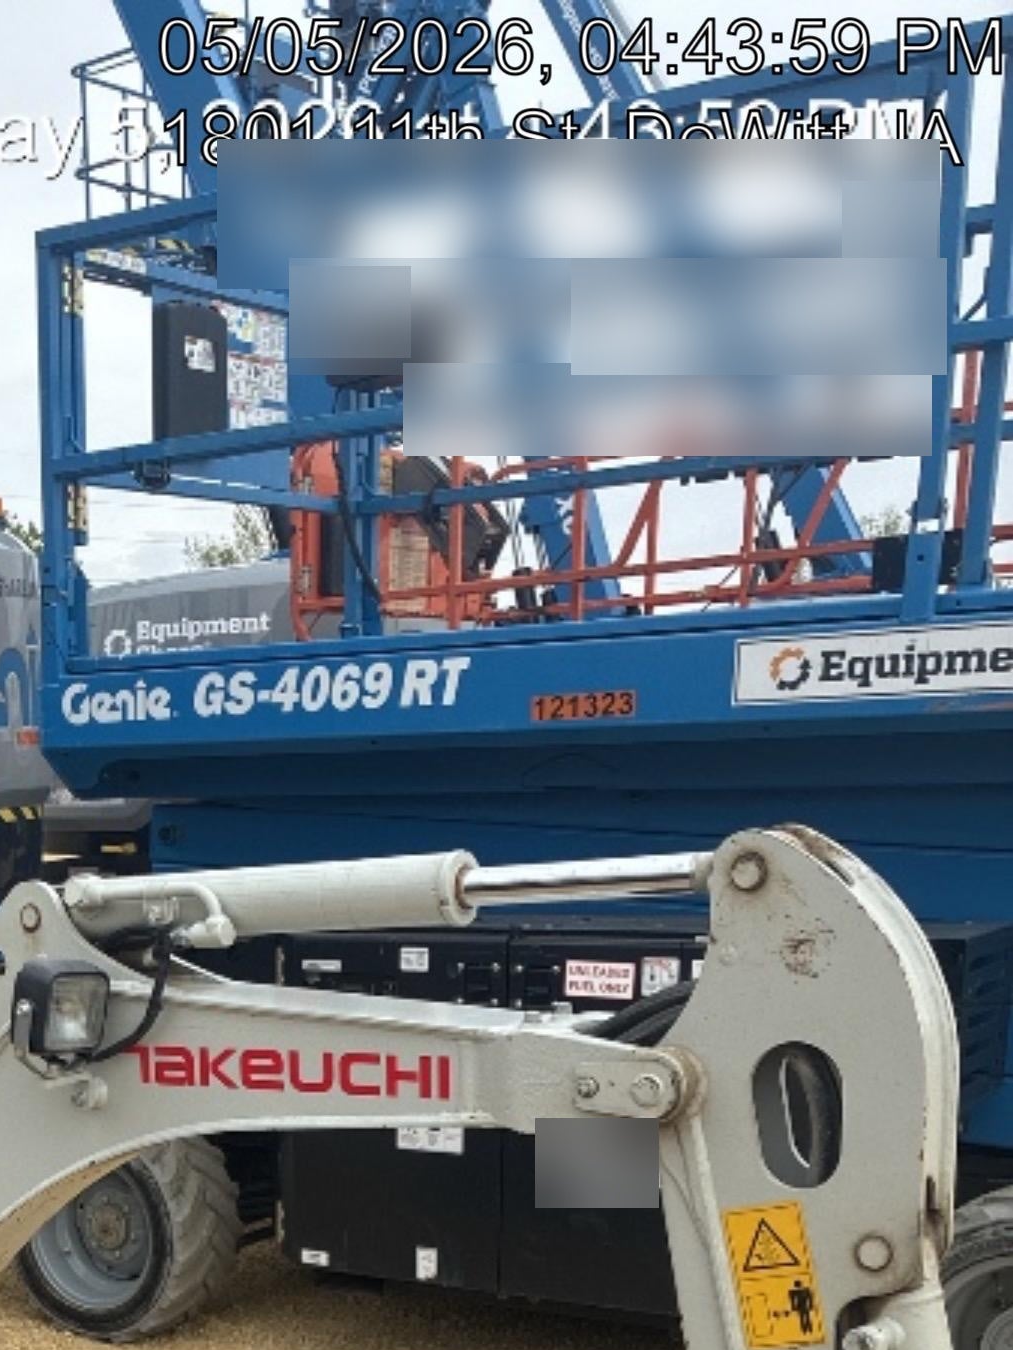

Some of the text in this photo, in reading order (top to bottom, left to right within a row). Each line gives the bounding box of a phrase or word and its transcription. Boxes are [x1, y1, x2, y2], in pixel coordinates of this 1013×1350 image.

[136, 611, 272, 643] Equipment
[61, 656, 471, 727] Genie GS-4069 RT
[535, 692, 634, 721] 121323
